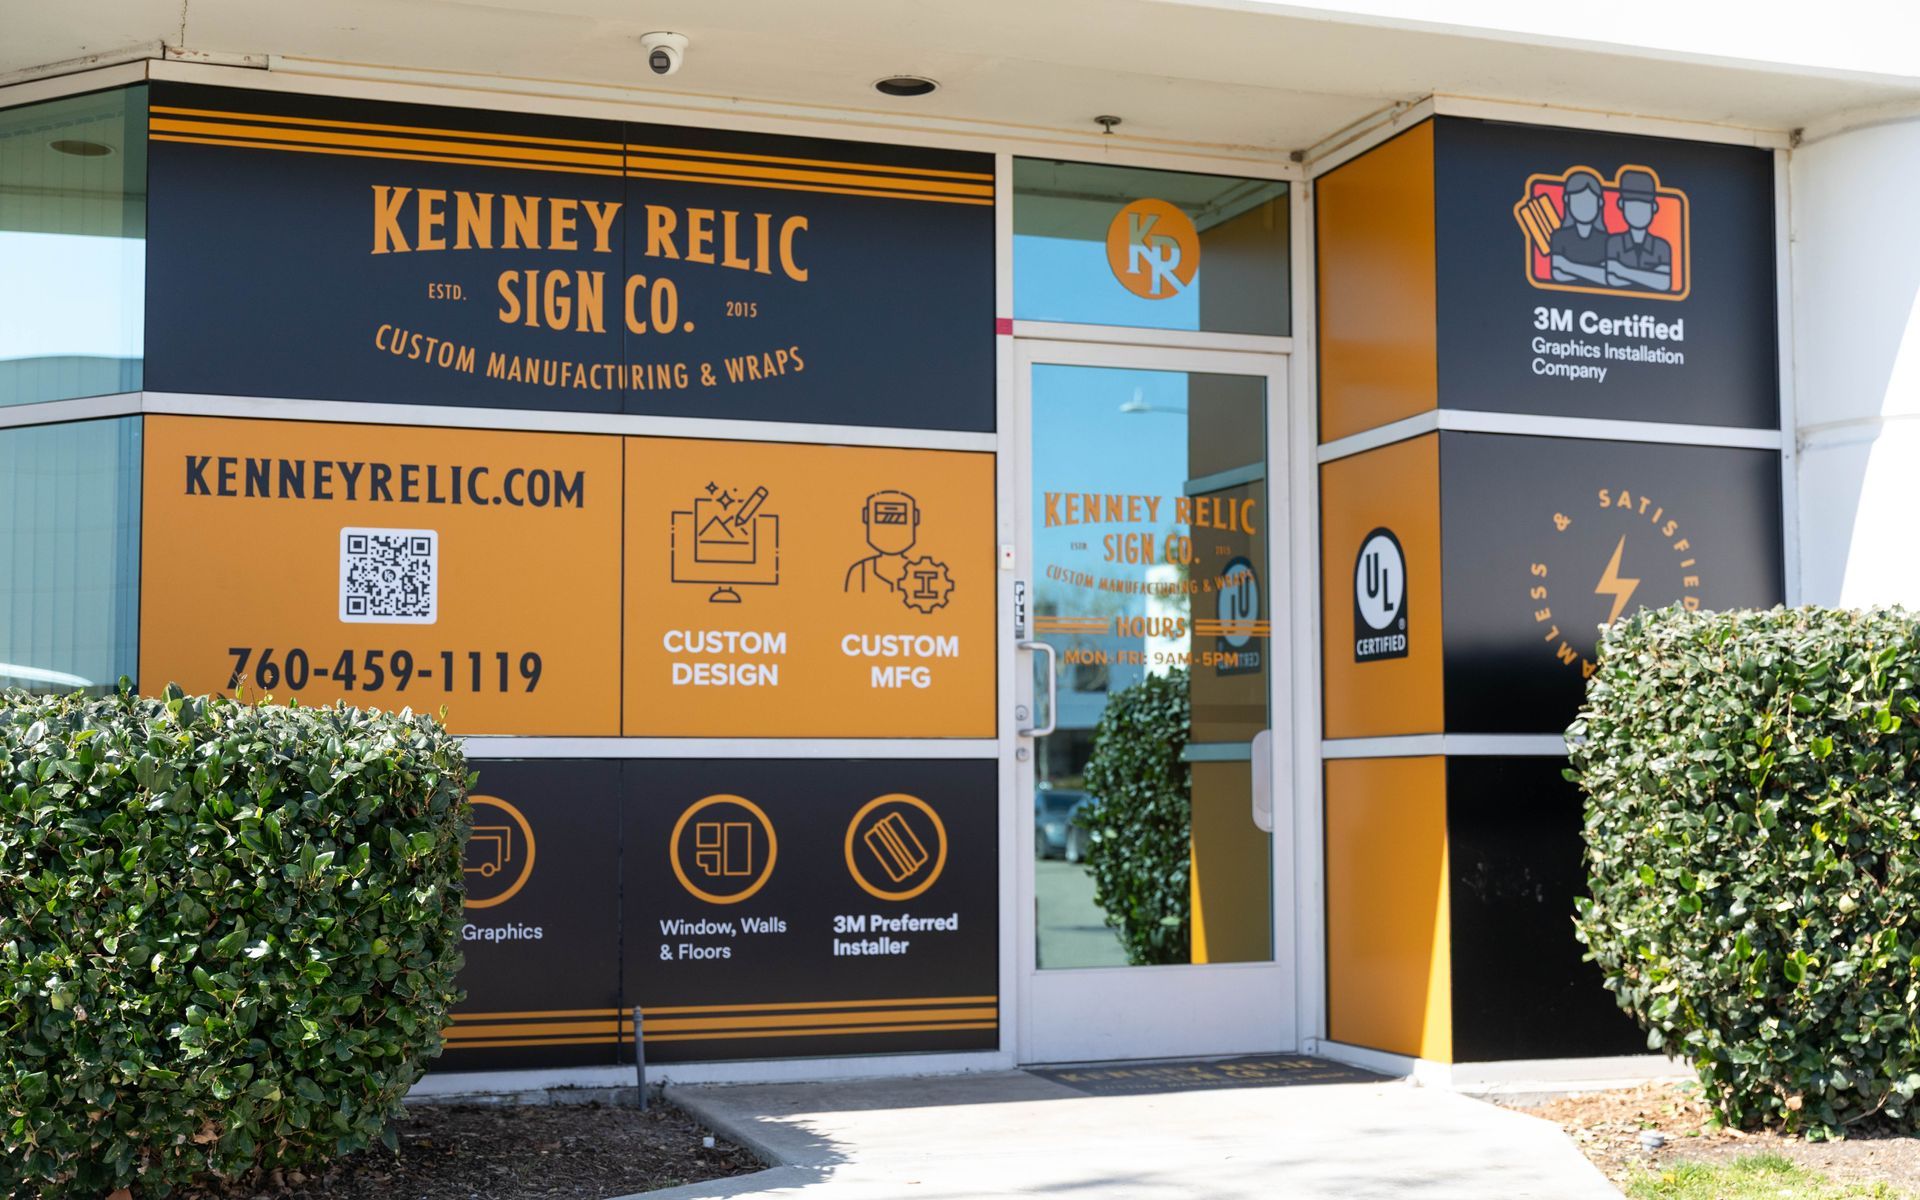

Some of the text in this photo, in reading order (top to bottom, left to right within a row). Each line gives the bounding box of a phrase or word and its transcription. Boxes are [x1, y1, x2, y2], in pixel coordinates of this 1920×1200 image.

[371, 185, 808, 282] KENNEY RELIC
[428, 283, 467, 301] ESTD.
[498, 269, 695, 334] SIGN CO.
[726, 301, 758, 319] 2015
[1533, 306, 1684, 341] 3M Certified
[375, 324, 805, 390] CUSTOM MANUFACTURING & WRAPS
[1532, 337, 1684, 365] Graphics Installation
[1532, 358, 1607, 383] Company
[184, 455, 586, 509] KENNEYRELIC.COM
[1044, 492, 1256, 535] KENNEY RELIC
[1553, 512, 1572, 532] &
[1103, 533, 1200, 565] SIGN CO.
[1598, 489, 1699, 612] SATISFIED
[1046, 564, 1094, 588] CUSTOM
[1366, 552, 1394, 612] UL
[1015, 584, 1024, 626] PULL
[1116, 617, 1186, 638] HOURS
[663, 630, 787, 654] CUSTOM
[841, 634, 959, 657] CUSTOM
[1356, 634, 1406, 656] CERTIFIED
[226, 647, 543, 693] 760-459-1119
[672, 663, 779, 686] DESIGN
[871, 666, 931, 688] MFG
[461, 922, 543, 944] Graphics
[659, 917, 787, 938] Window, Walls
[833, 913, 959, 934] 3M Preferred
[660, 943, 731, 960] & Floors
[833, 938, 909, 957] Installer
